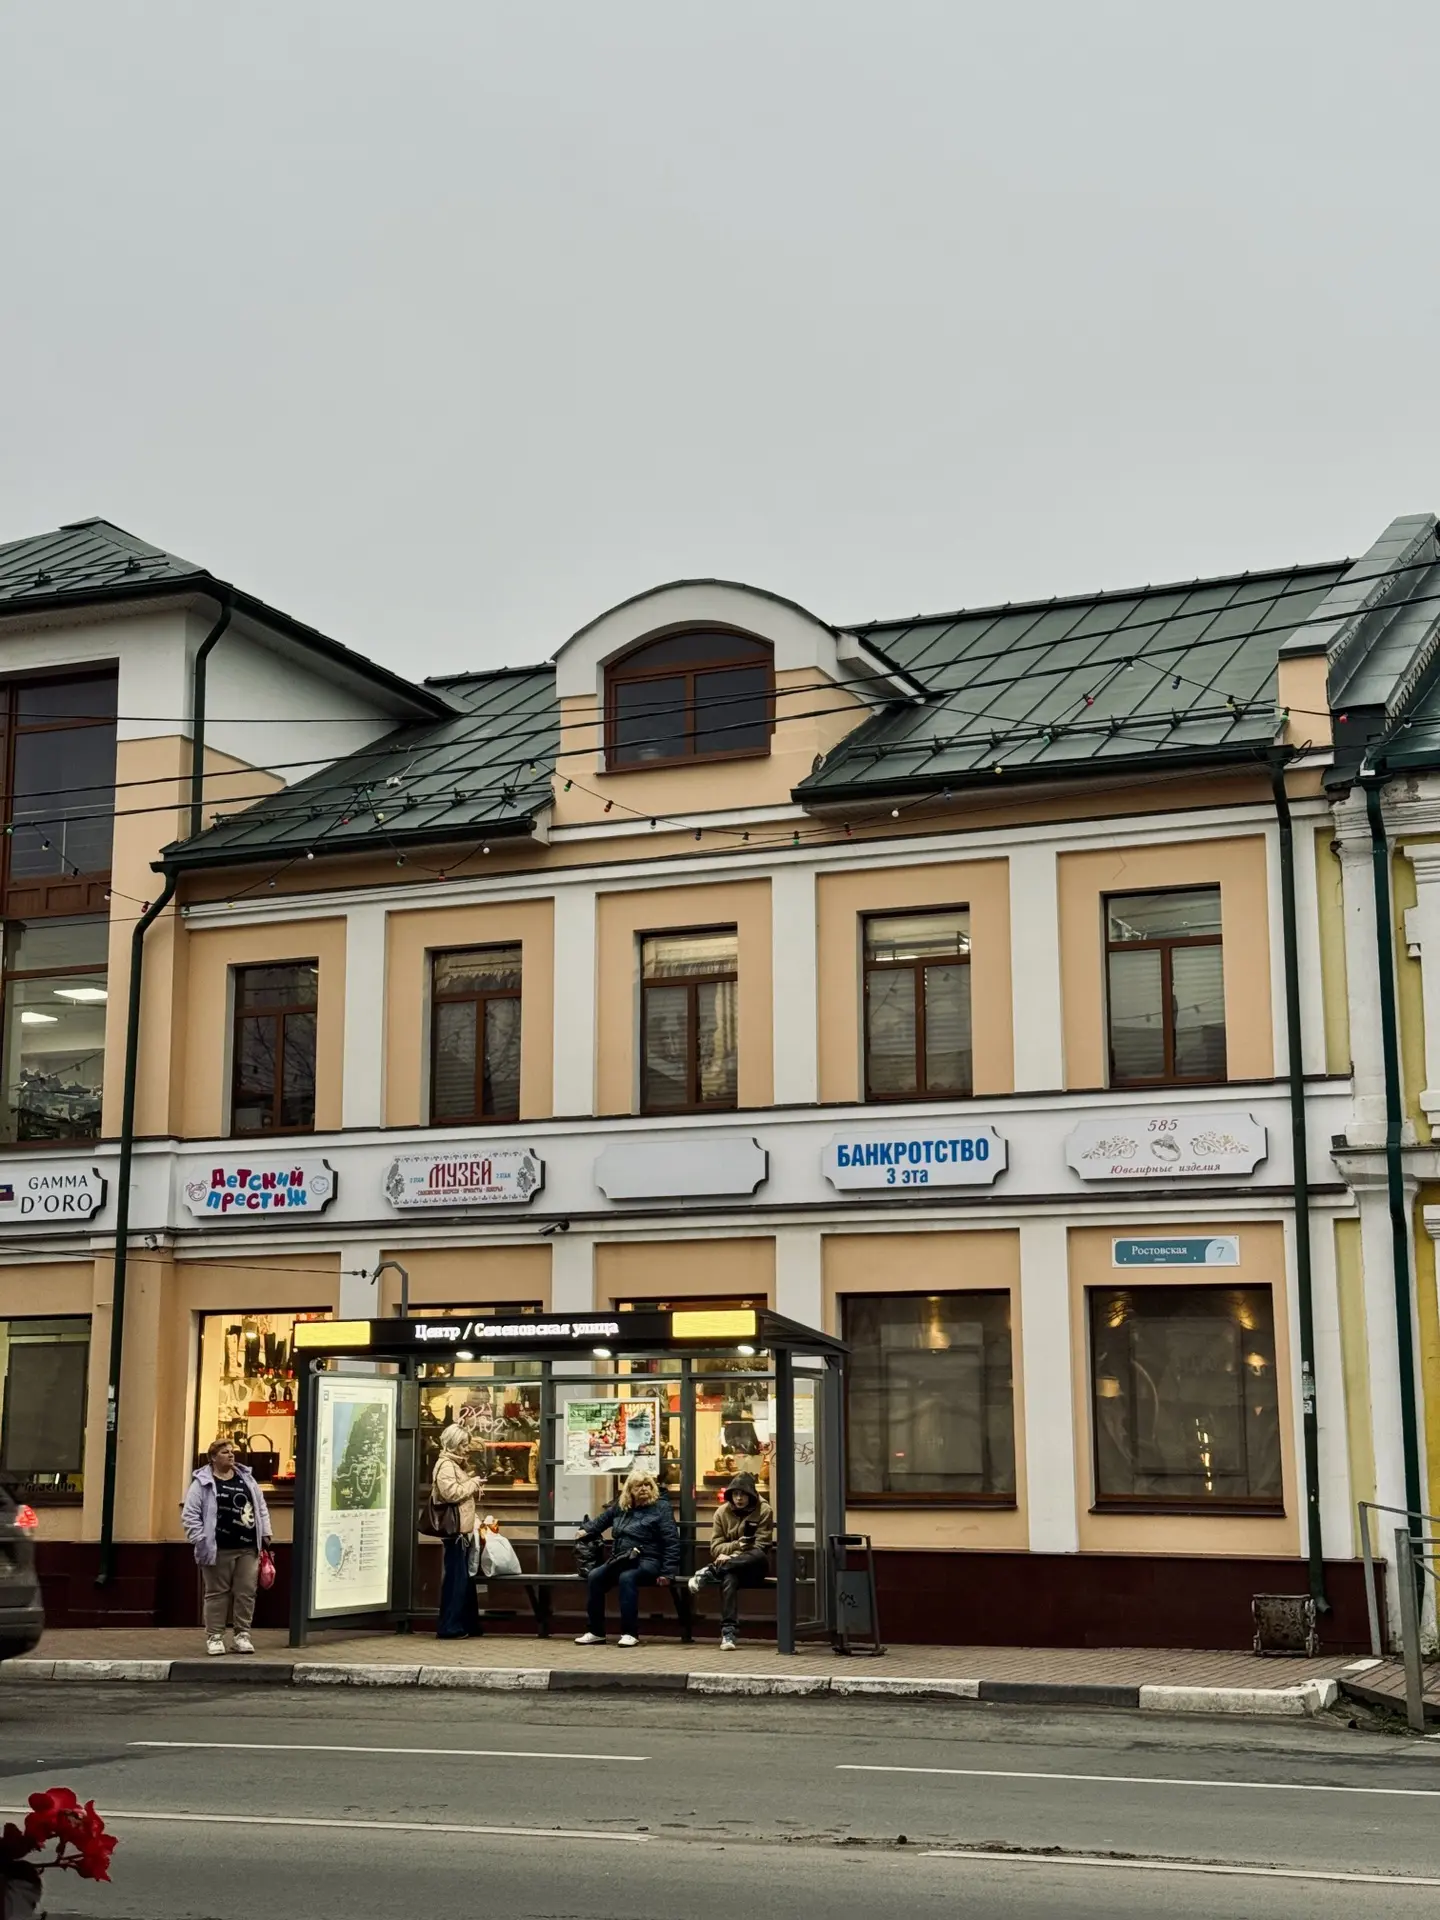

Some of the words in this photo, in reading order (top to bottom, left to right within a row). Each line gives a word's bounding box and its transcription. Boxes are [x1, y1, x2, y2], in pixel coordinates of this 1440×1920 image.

[1147, 1118, 1179, 1132] 585
[837, 1138, 989, 1167] БАНКРОТСТВО
[429, 1158, 492, 1188] МУЗЕЙ
[886, 1168, 896, 1184] 3
[901, 1169, 929, 1184] эта
[1109, 1164, 1173, 1175] Ювелирные
[1178, 1163, 1221, 1172] изделия
[28, 1174, 88, 1190] GAMMA
[20, 1193, 93, 1214] D'ORO
[1131, 1245, 1187, 1255] Ростовская
[1216, 1246, 1225, 1258] 7
[415, 1324, 460, 1340] Центр
[462, 1322, 473, 1340] /
[571, 1322, 619, 1338] улица
